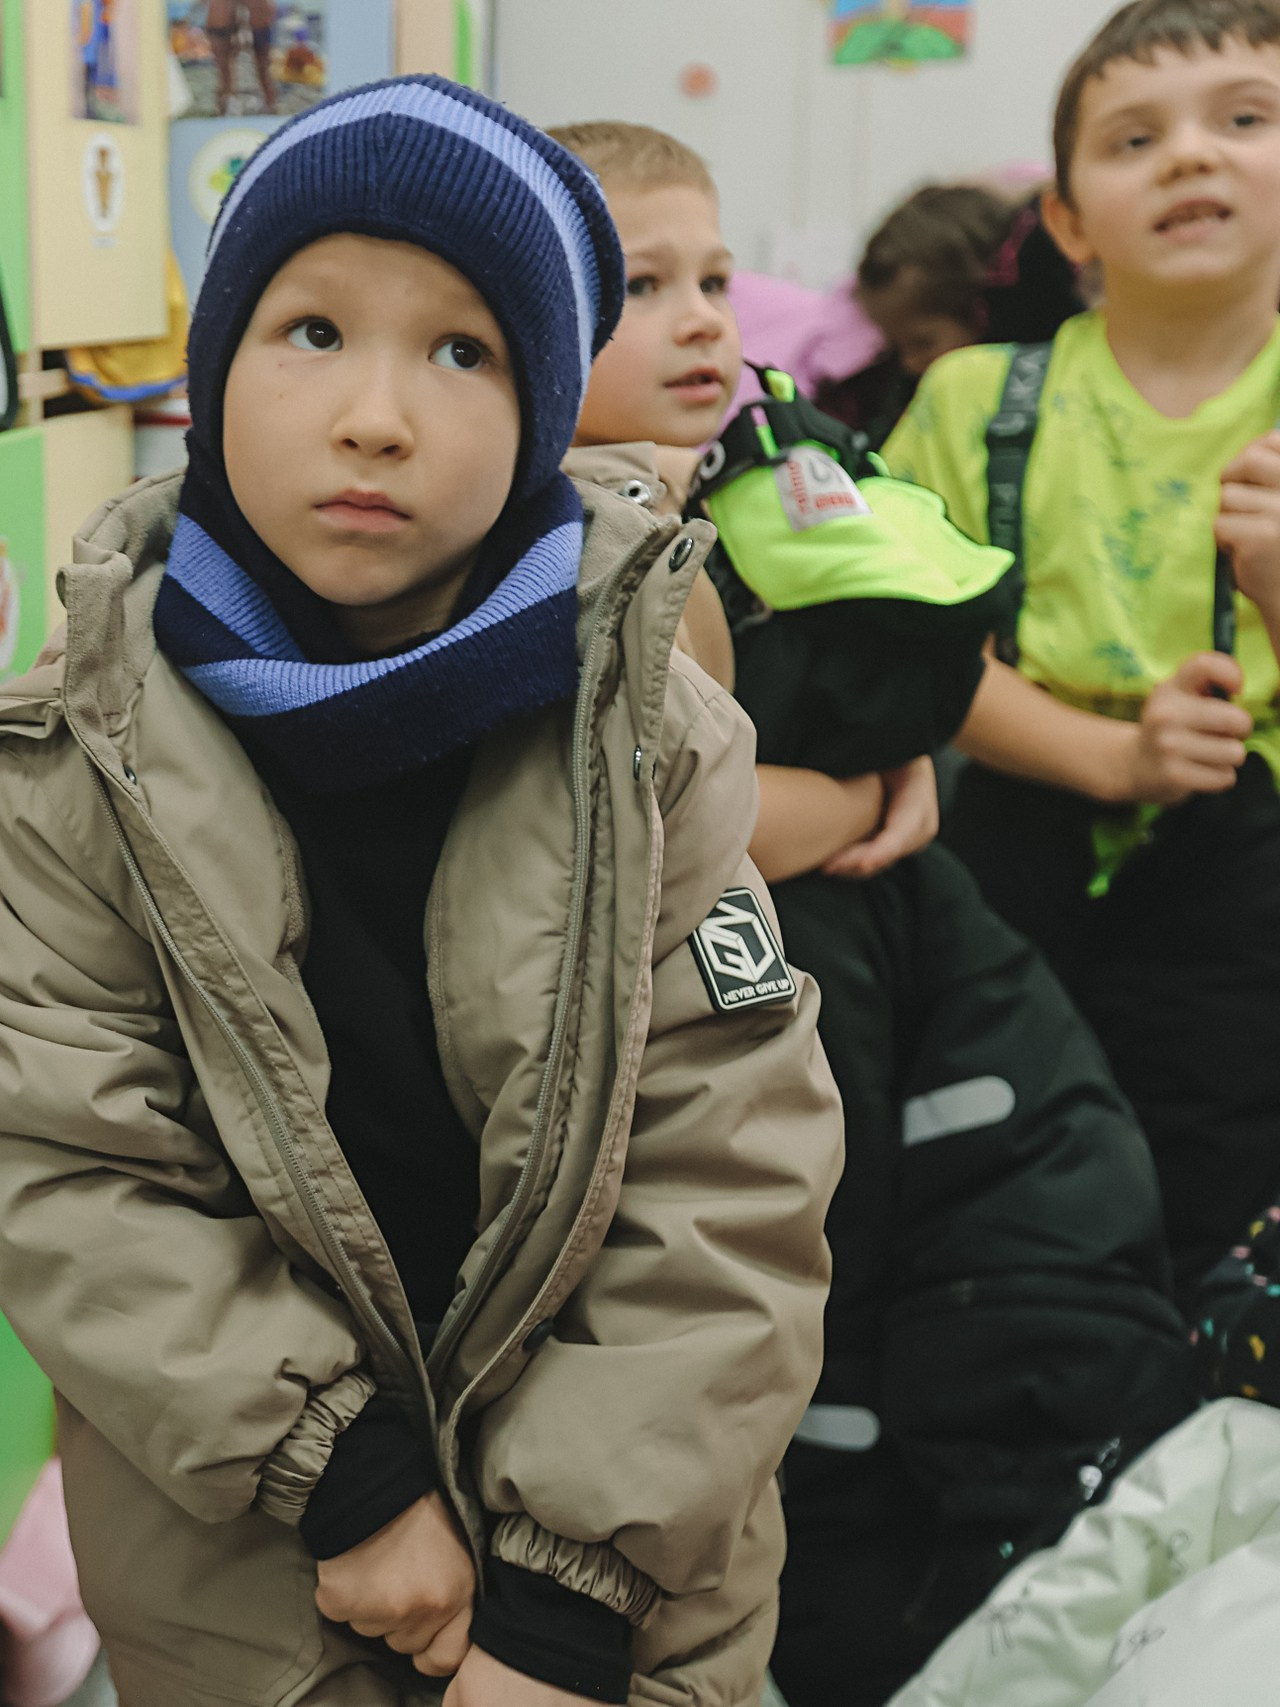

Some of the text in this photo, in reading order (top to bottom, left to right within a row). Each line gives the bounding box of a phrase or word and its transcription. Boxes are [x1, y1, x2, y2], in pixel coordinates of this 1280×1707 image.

[722, 978, 790, 1004] NEVER GIVE UP
